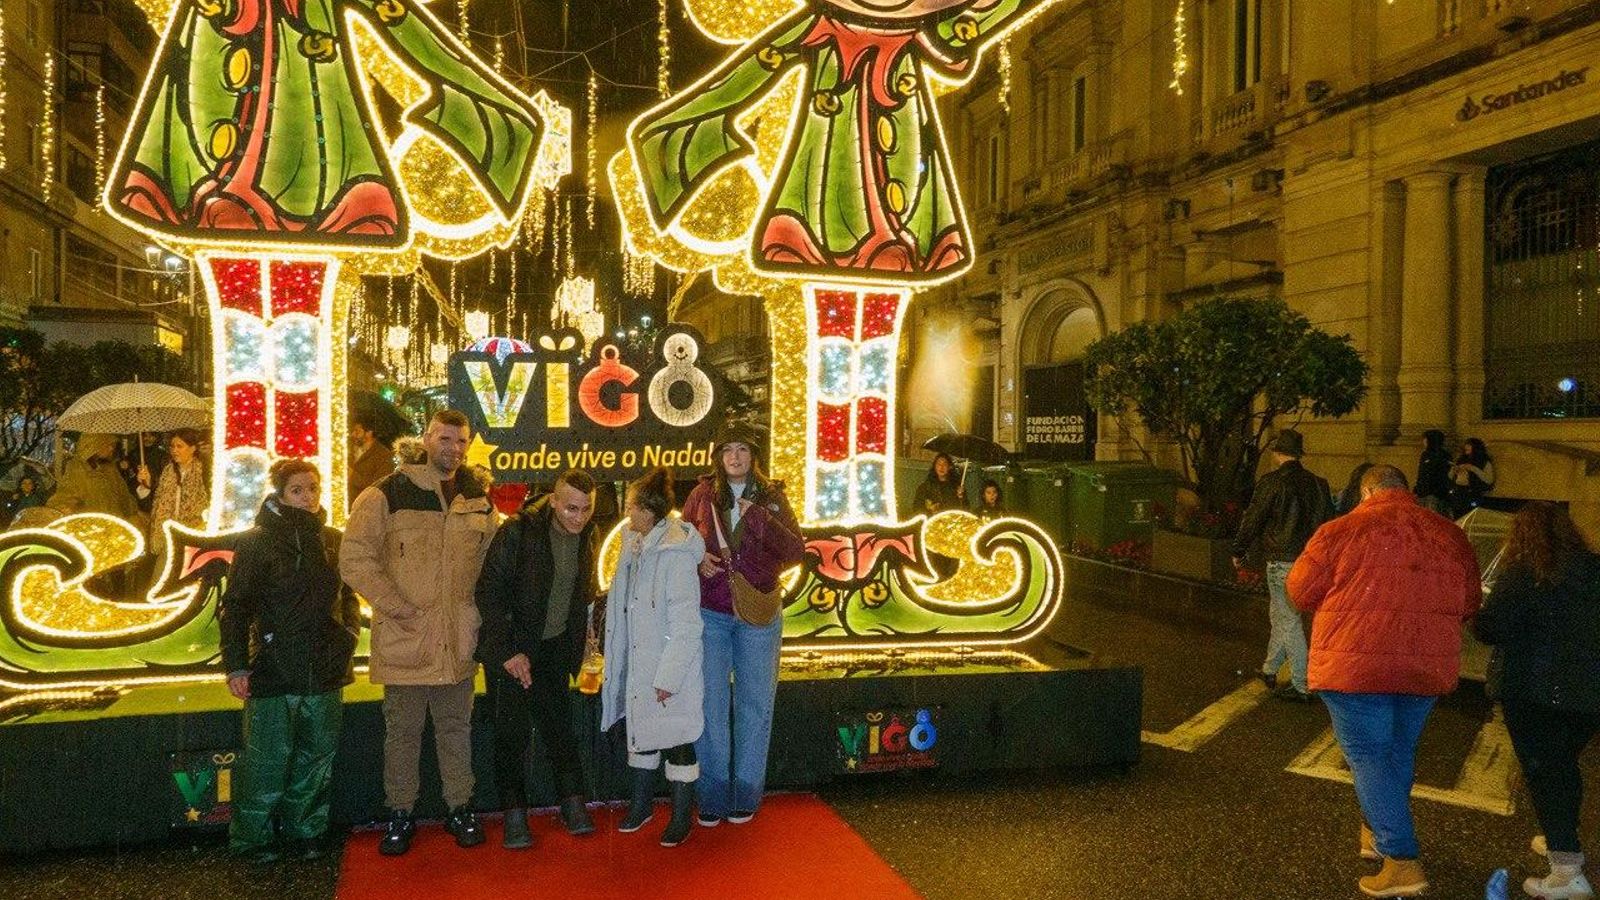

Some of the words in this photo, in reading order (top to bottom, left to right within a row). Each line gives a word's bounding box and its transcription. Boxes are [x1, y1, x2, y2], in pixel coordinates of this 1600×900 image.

[1482, 66, 1591, 116] Santander
[495, 443, 561, 469] onde
[567, 443, 616, 468] vive
[621, 449, 636, 468] o
[642, 442, 714, 467] Nadal
[1053, 434, 1084, 443] MAZA
[172, 753, 233, 804] VI
